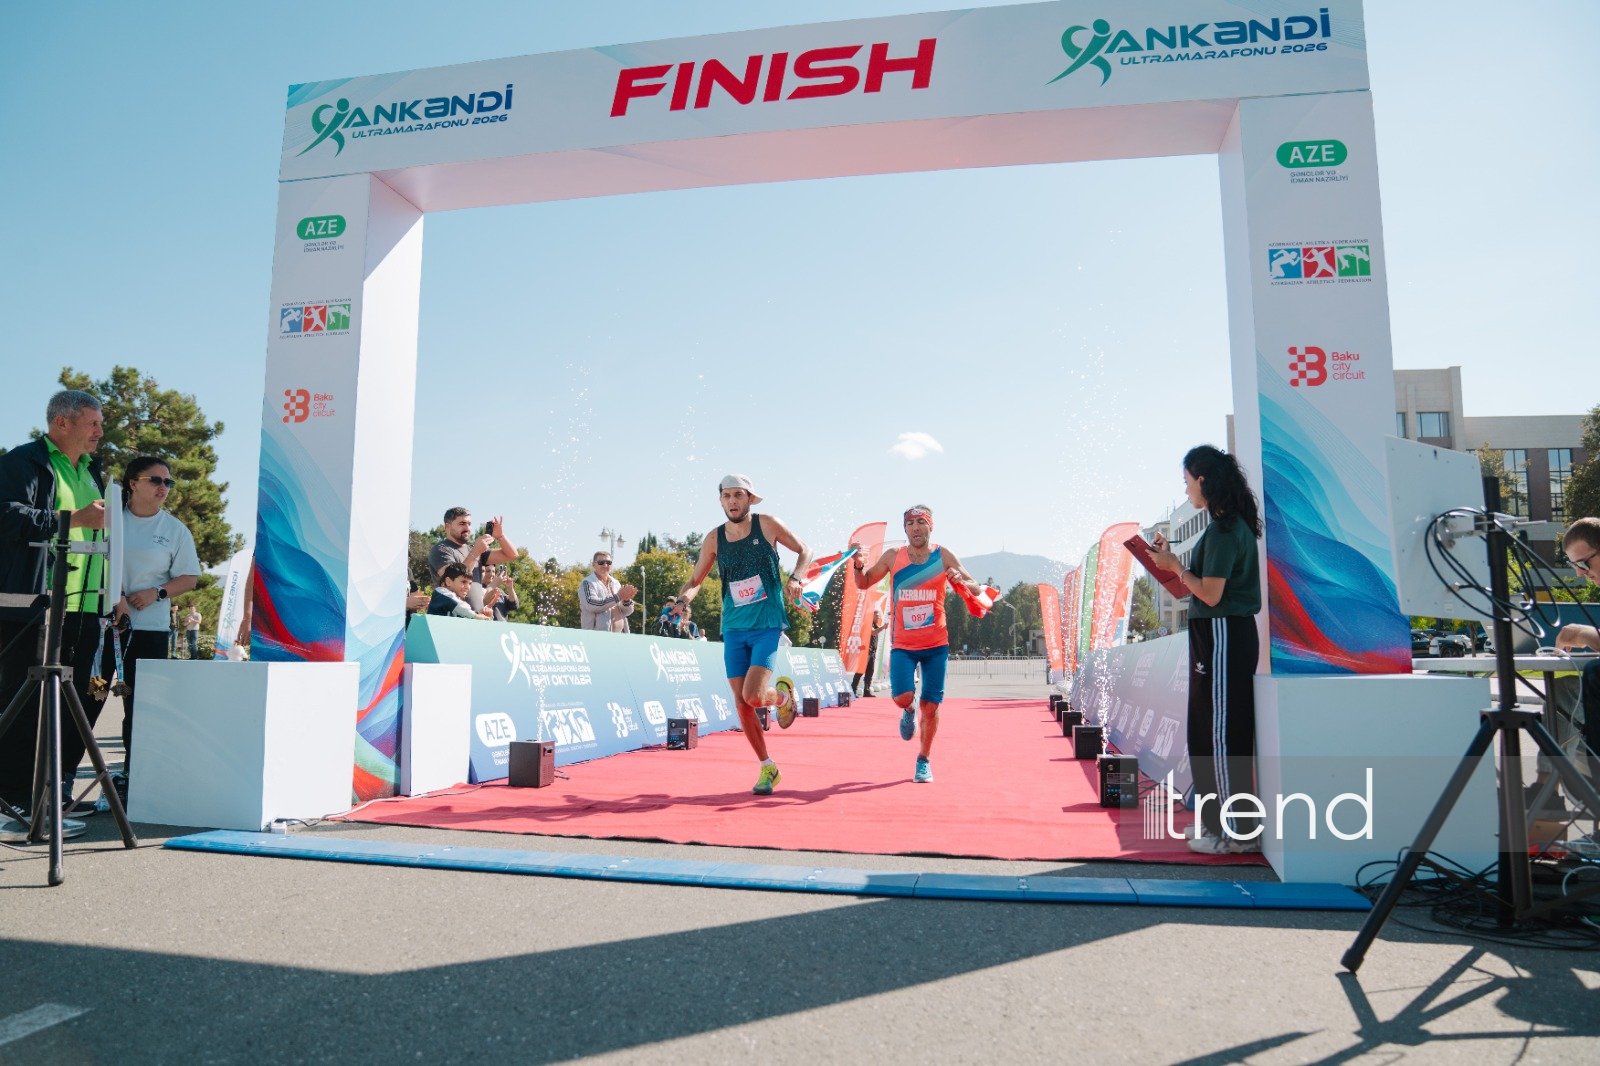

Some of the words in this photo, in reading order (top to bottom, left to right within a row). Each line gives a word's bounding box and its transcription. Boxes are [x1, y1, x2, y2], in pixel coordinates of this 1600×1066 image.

[1120, 47, 1277, 66] ULTRAMARAFONU
[1281, 42, 1328, 54] 2026
[610, 38, 938, 117] FINISH
[352, 118, 470, 139] ULTRAMARAFONU
[472, 113, 509, 125] 2026
[1289, 144, 1335, 164] AZE
[304, 219, 338, 237] AZE
[1331, 351, 1360, 361] Baku
[1331, 362, 1352, 373] city
[1332, 370, 1366, 380] circuit
[738, 587, 756, 599] 032
[911, 612, 927, 623] 087
[484, 718, 511, 741] AZE
